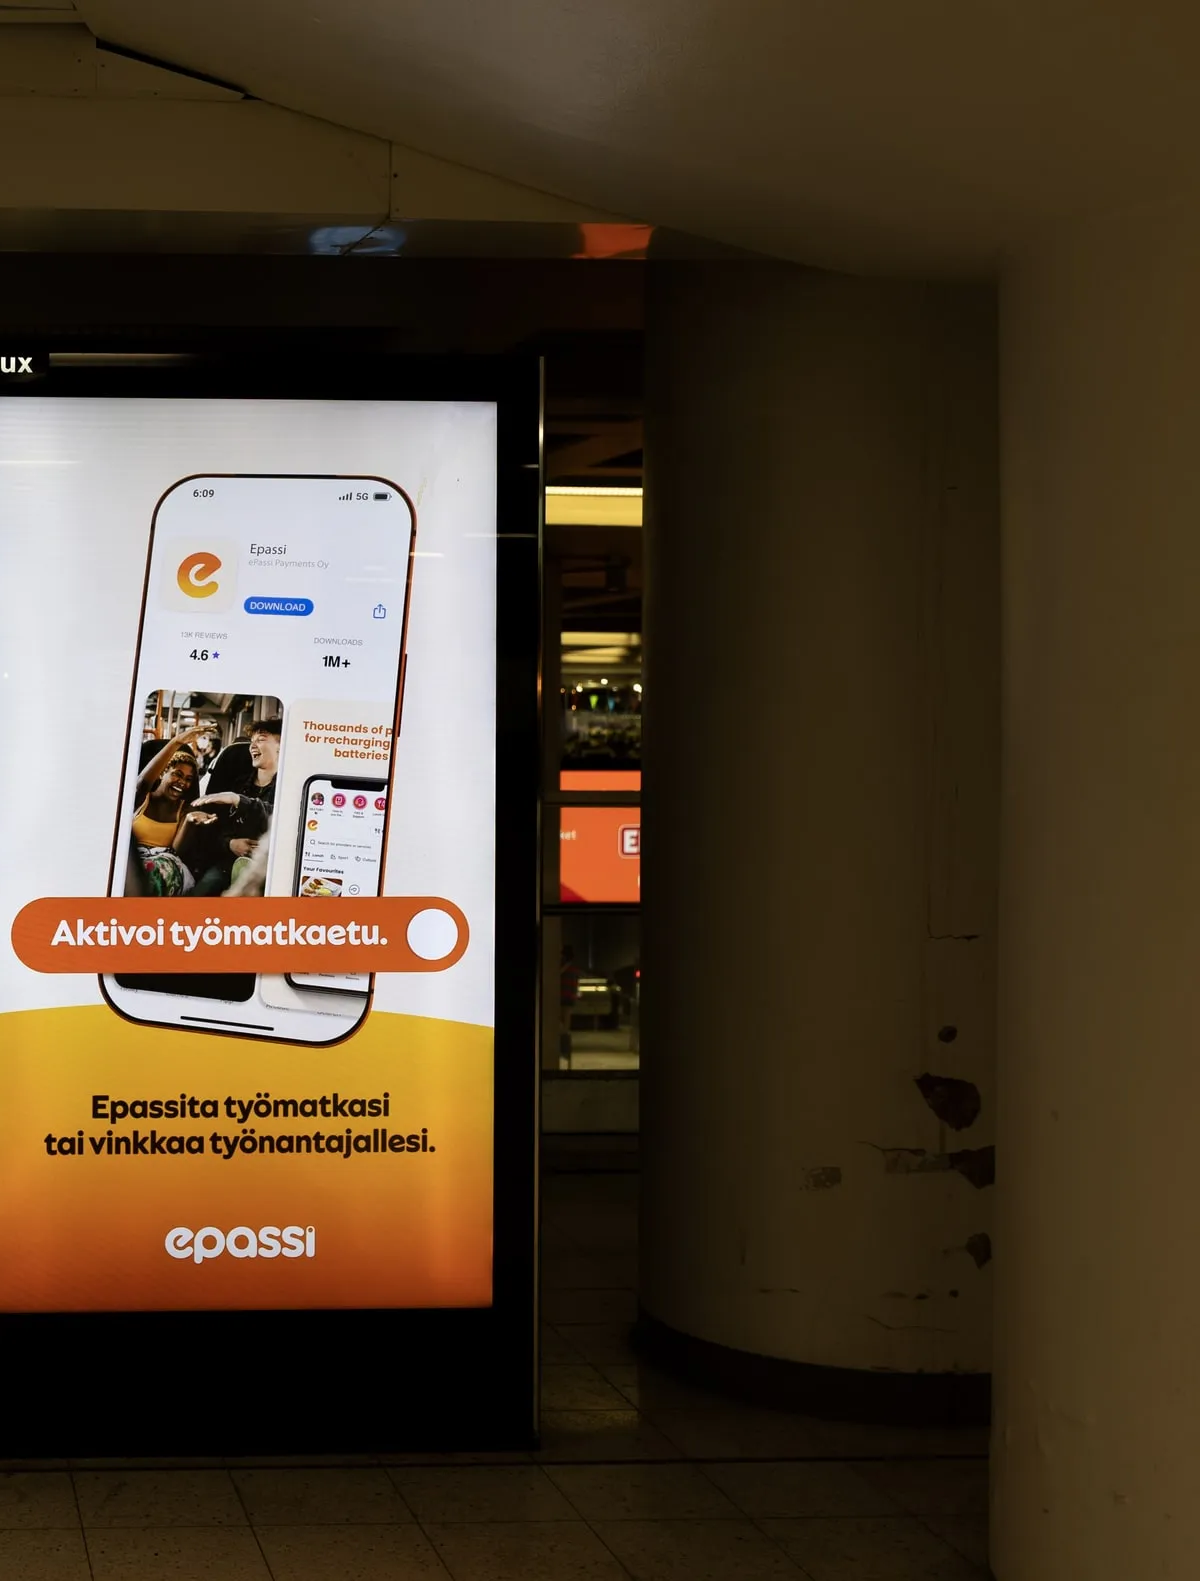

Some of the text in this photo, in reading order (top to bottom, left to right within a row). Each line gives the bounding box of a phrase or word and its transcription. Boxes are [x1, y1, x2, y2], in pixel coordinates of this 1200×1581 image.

[193, 489, 215, 498] 6:09
[356, 492, 369, 501] 5G
[250, 543, 287, 557] Epassi
[248, 559, 330, 569] ePassi Payments Oy
[250, 601, 306, 611] DOWNLOAD
[194, 632, 228, 640] REVIEWS
[313, 637, 363, 646] DOWNLOADS
[189, 649, 209, 661] 4.6
[322, 656, 351, 668] 1M+
[303, 721, 368, 734] Thousands
[371, 725, 383, 735] of
[305, 733, 390, 751] for recharging
[334, 748, 388, 760] batteries
[316, 867, 344, 875] Favourites
[51, 917, 388, 952] Aktivoi työmatkaetu.
[92, 1092, 390, 1124] Epassita työmatkasi
[44, 1128, 436, 1159] tai vinkkaa työnantajallesi.
[164, 1225, 315, 1264] epassi
